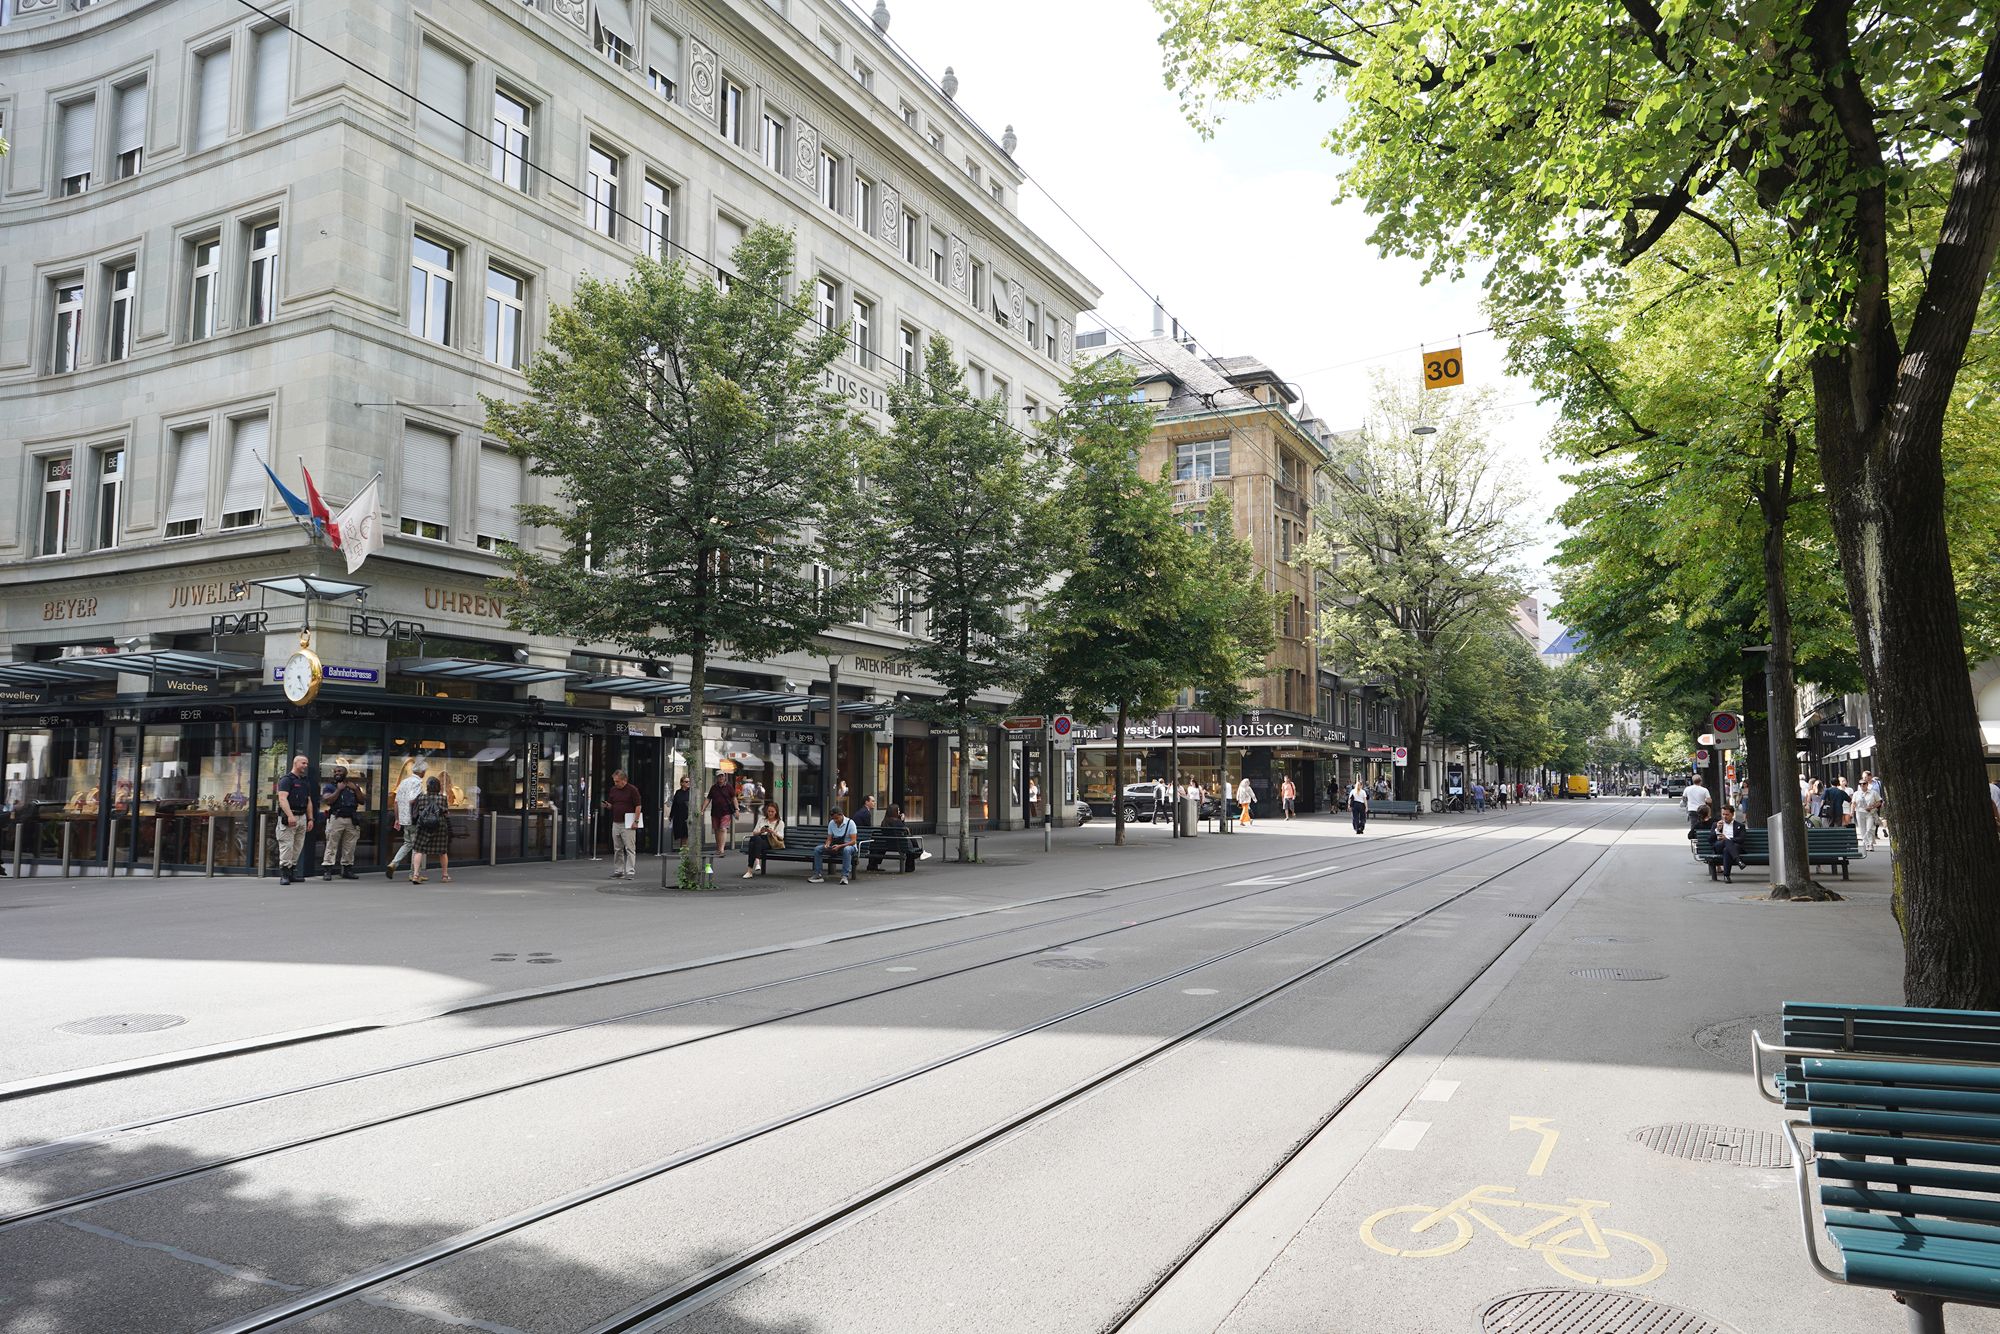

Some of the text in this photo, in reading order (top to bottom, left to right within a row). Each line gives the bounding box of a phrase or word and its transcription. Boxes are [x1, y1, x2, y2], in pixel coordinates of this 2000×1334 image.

[1427, 358, 1461, 382] 30
[51, 464, 72, 476] BEYE
[168, 579, 252, 608] JUWELEN
[424, 586, 502, 619] UHREN
[43, 597, 98, 621] BEYER
[211, 610, 270, 637] BEYER
[350, 614, 426, 645] BEYER
[855, 656, 913, 678] PATEK PHILIPPE
[328, 667, 372, 680] Bahnhofstrasse
[167, 680, 208, 692] Watches
[0, 691, 40, 701] ewellery
[180, 710, 202, 720] BEYER
[663, 705, 684, 713] BEYER
[40, 716, 59, 725] BEYER
[452, 714, 479, 723] BEYER
[616, 724, 636, 732] BEYER
[1112, 725, 1200, 735] UYSSE NARDIN
[1219, 721, 1294, 736] meister
[1327, 730, 1346, 742] ZENITH
[530, 772, 538, 809] MUSEUM
